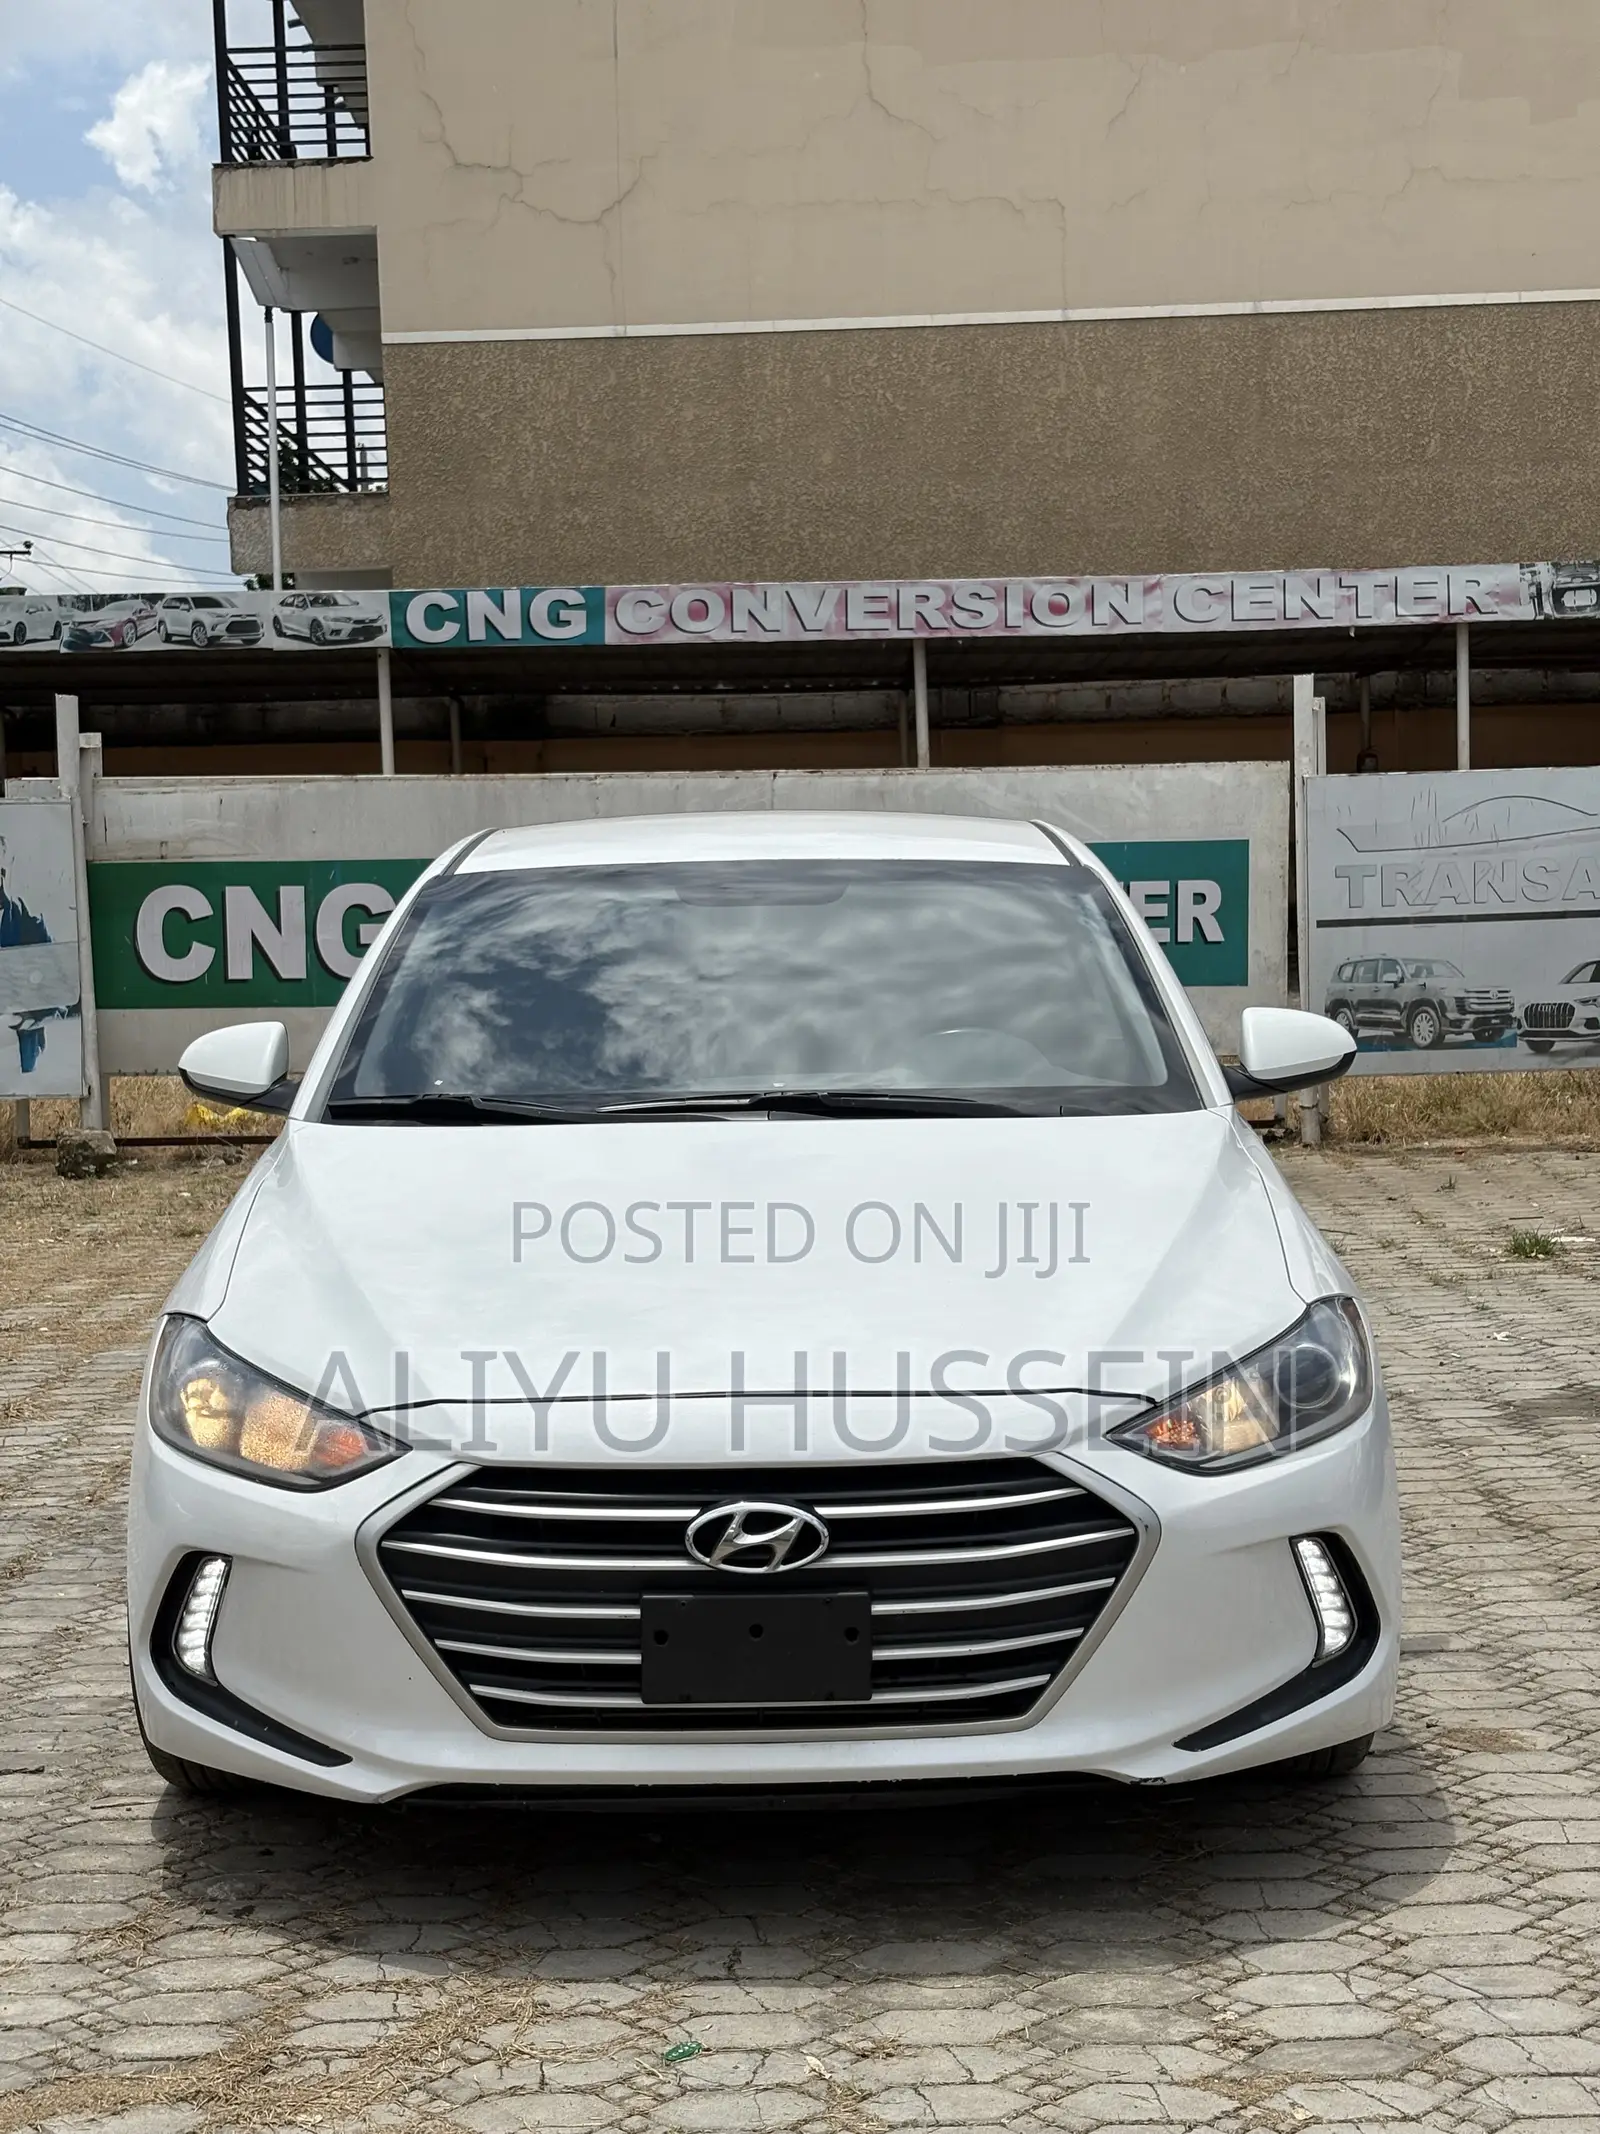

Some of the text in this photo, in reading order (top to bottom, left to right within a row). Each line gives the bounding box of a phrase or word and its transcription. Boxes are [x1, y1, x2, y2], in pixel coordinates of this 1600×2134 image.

[406, 572, 1499, 644] CNG CONVERSION CENTER
[134, 880, 1225, 983] CNG ER
